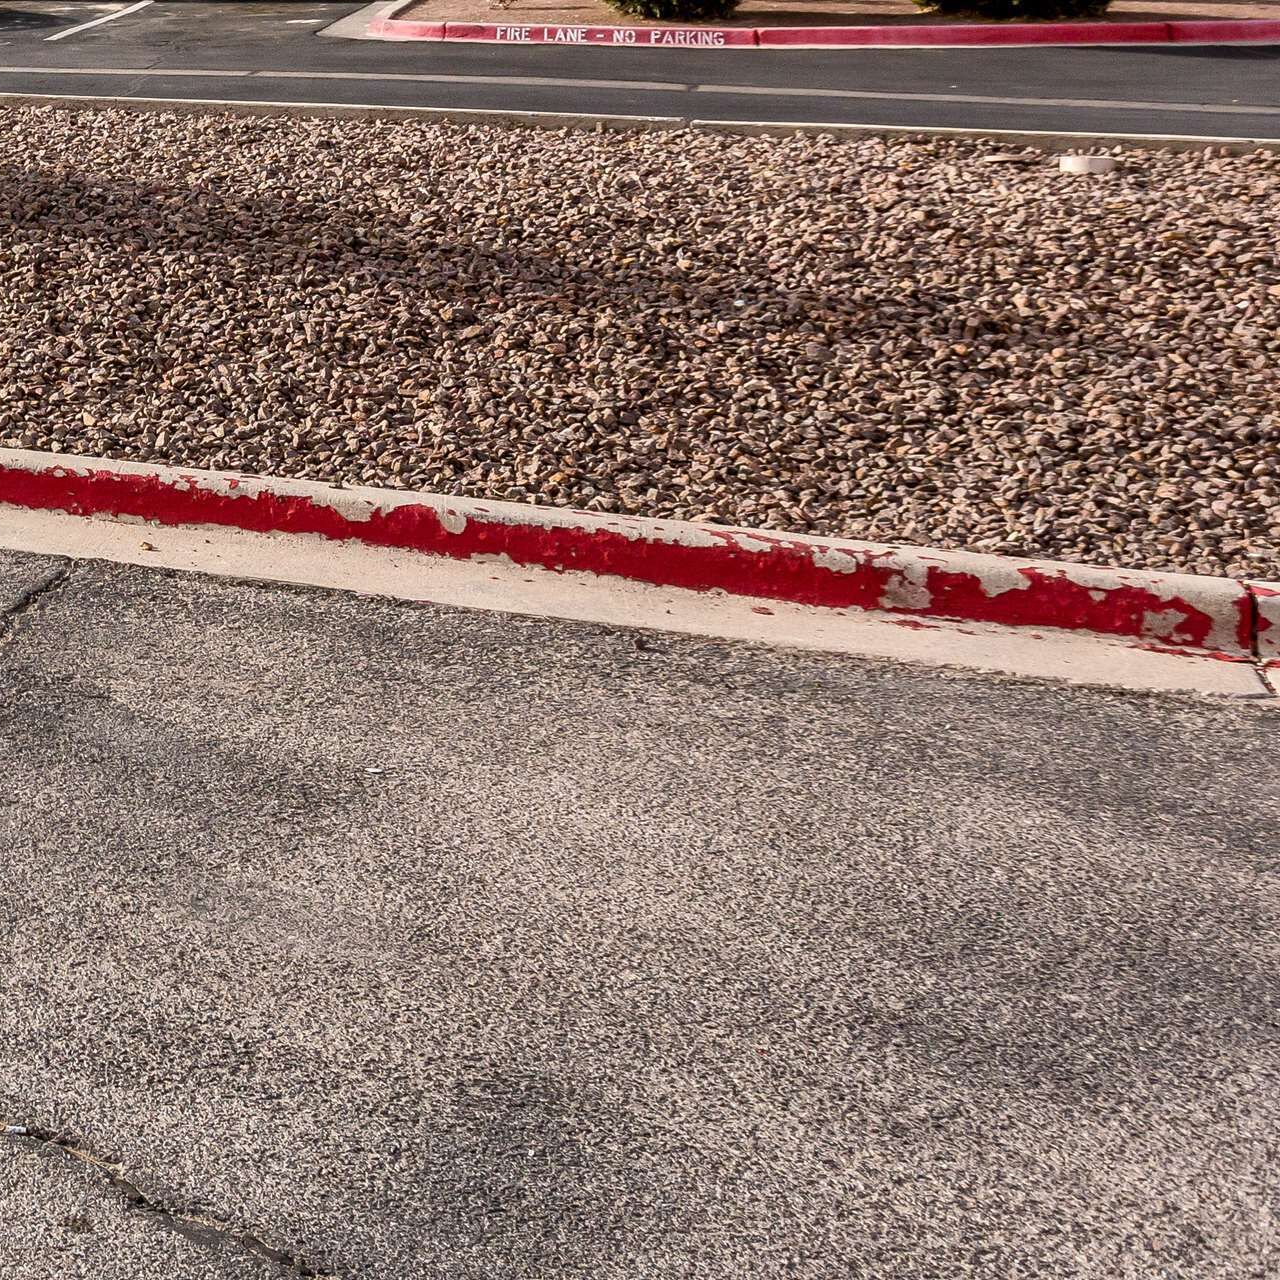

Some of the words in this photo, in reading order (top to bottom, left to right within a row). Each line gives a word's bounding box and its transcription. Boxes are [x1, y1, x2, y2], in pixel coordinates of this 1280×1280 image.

[496, 27, 531, 41] FIRE
[543, 28, 588, 43] LANE
[612, 30, 636, 44] NO
[650, 30, 725, 46] PARKING
